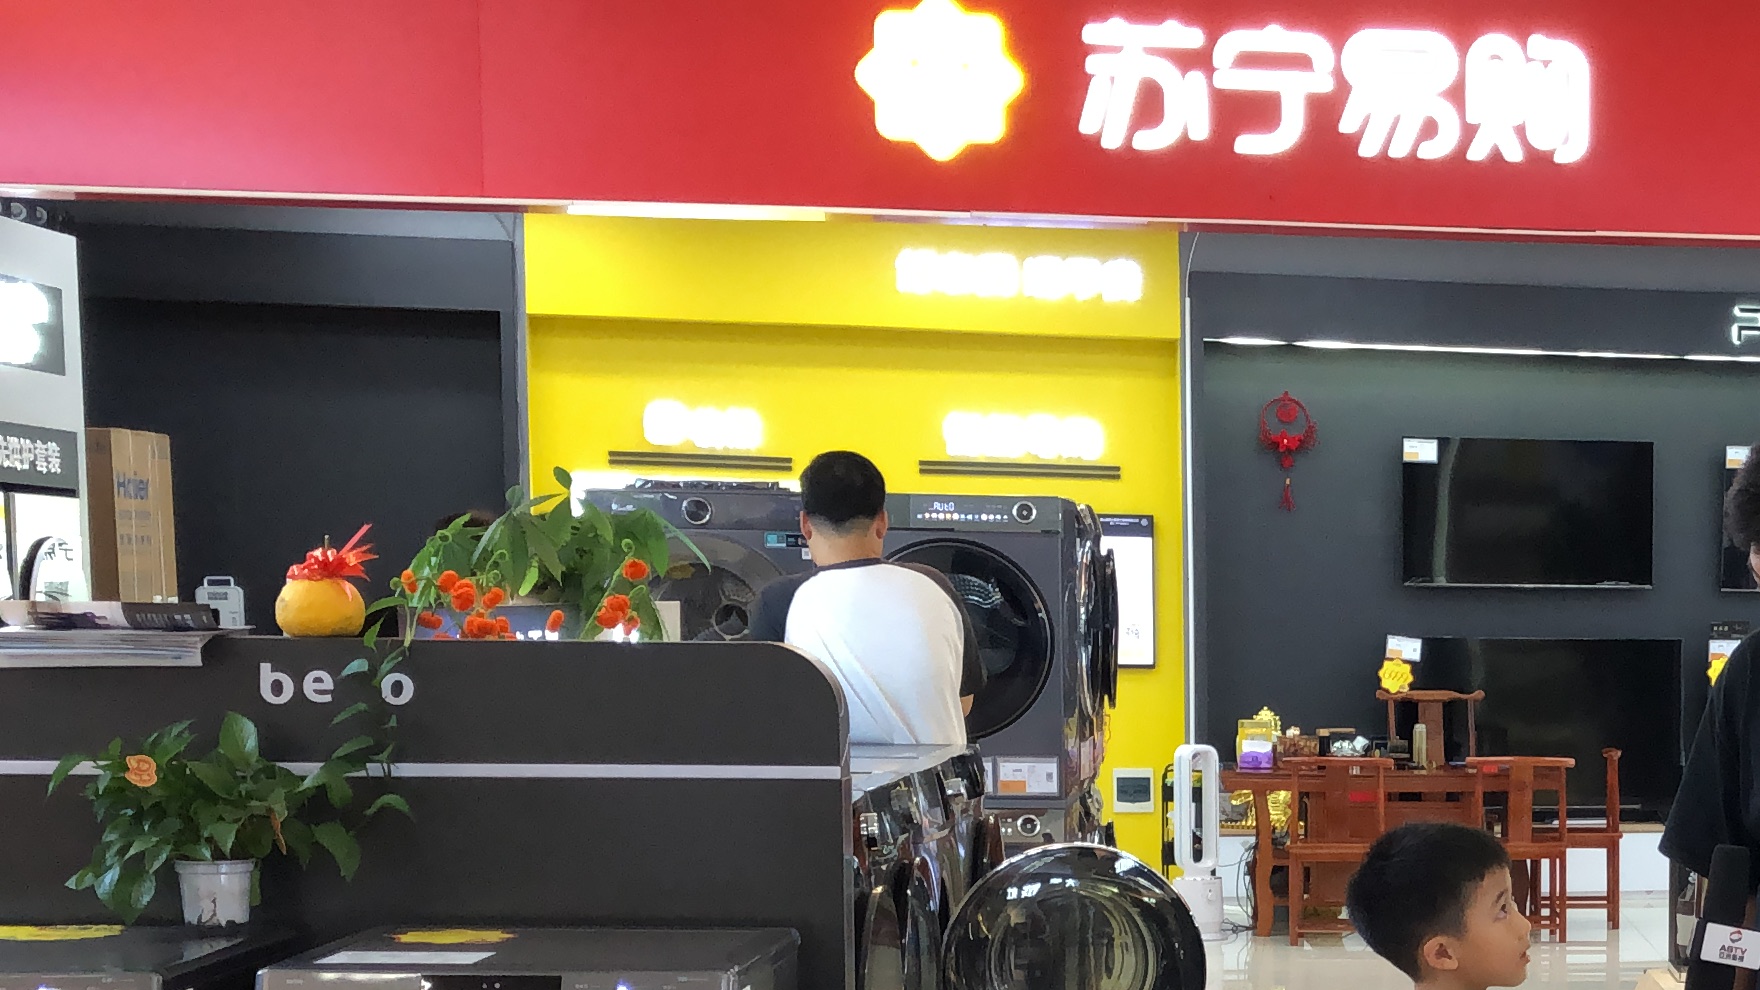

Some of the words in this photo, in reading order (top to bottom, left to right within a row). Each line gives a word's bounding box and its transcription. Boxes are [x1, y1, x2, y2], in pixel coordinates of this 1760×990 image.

[1079, 18, 1592, 165] 苏宁易购
[259, 661, 414, 706] beo
